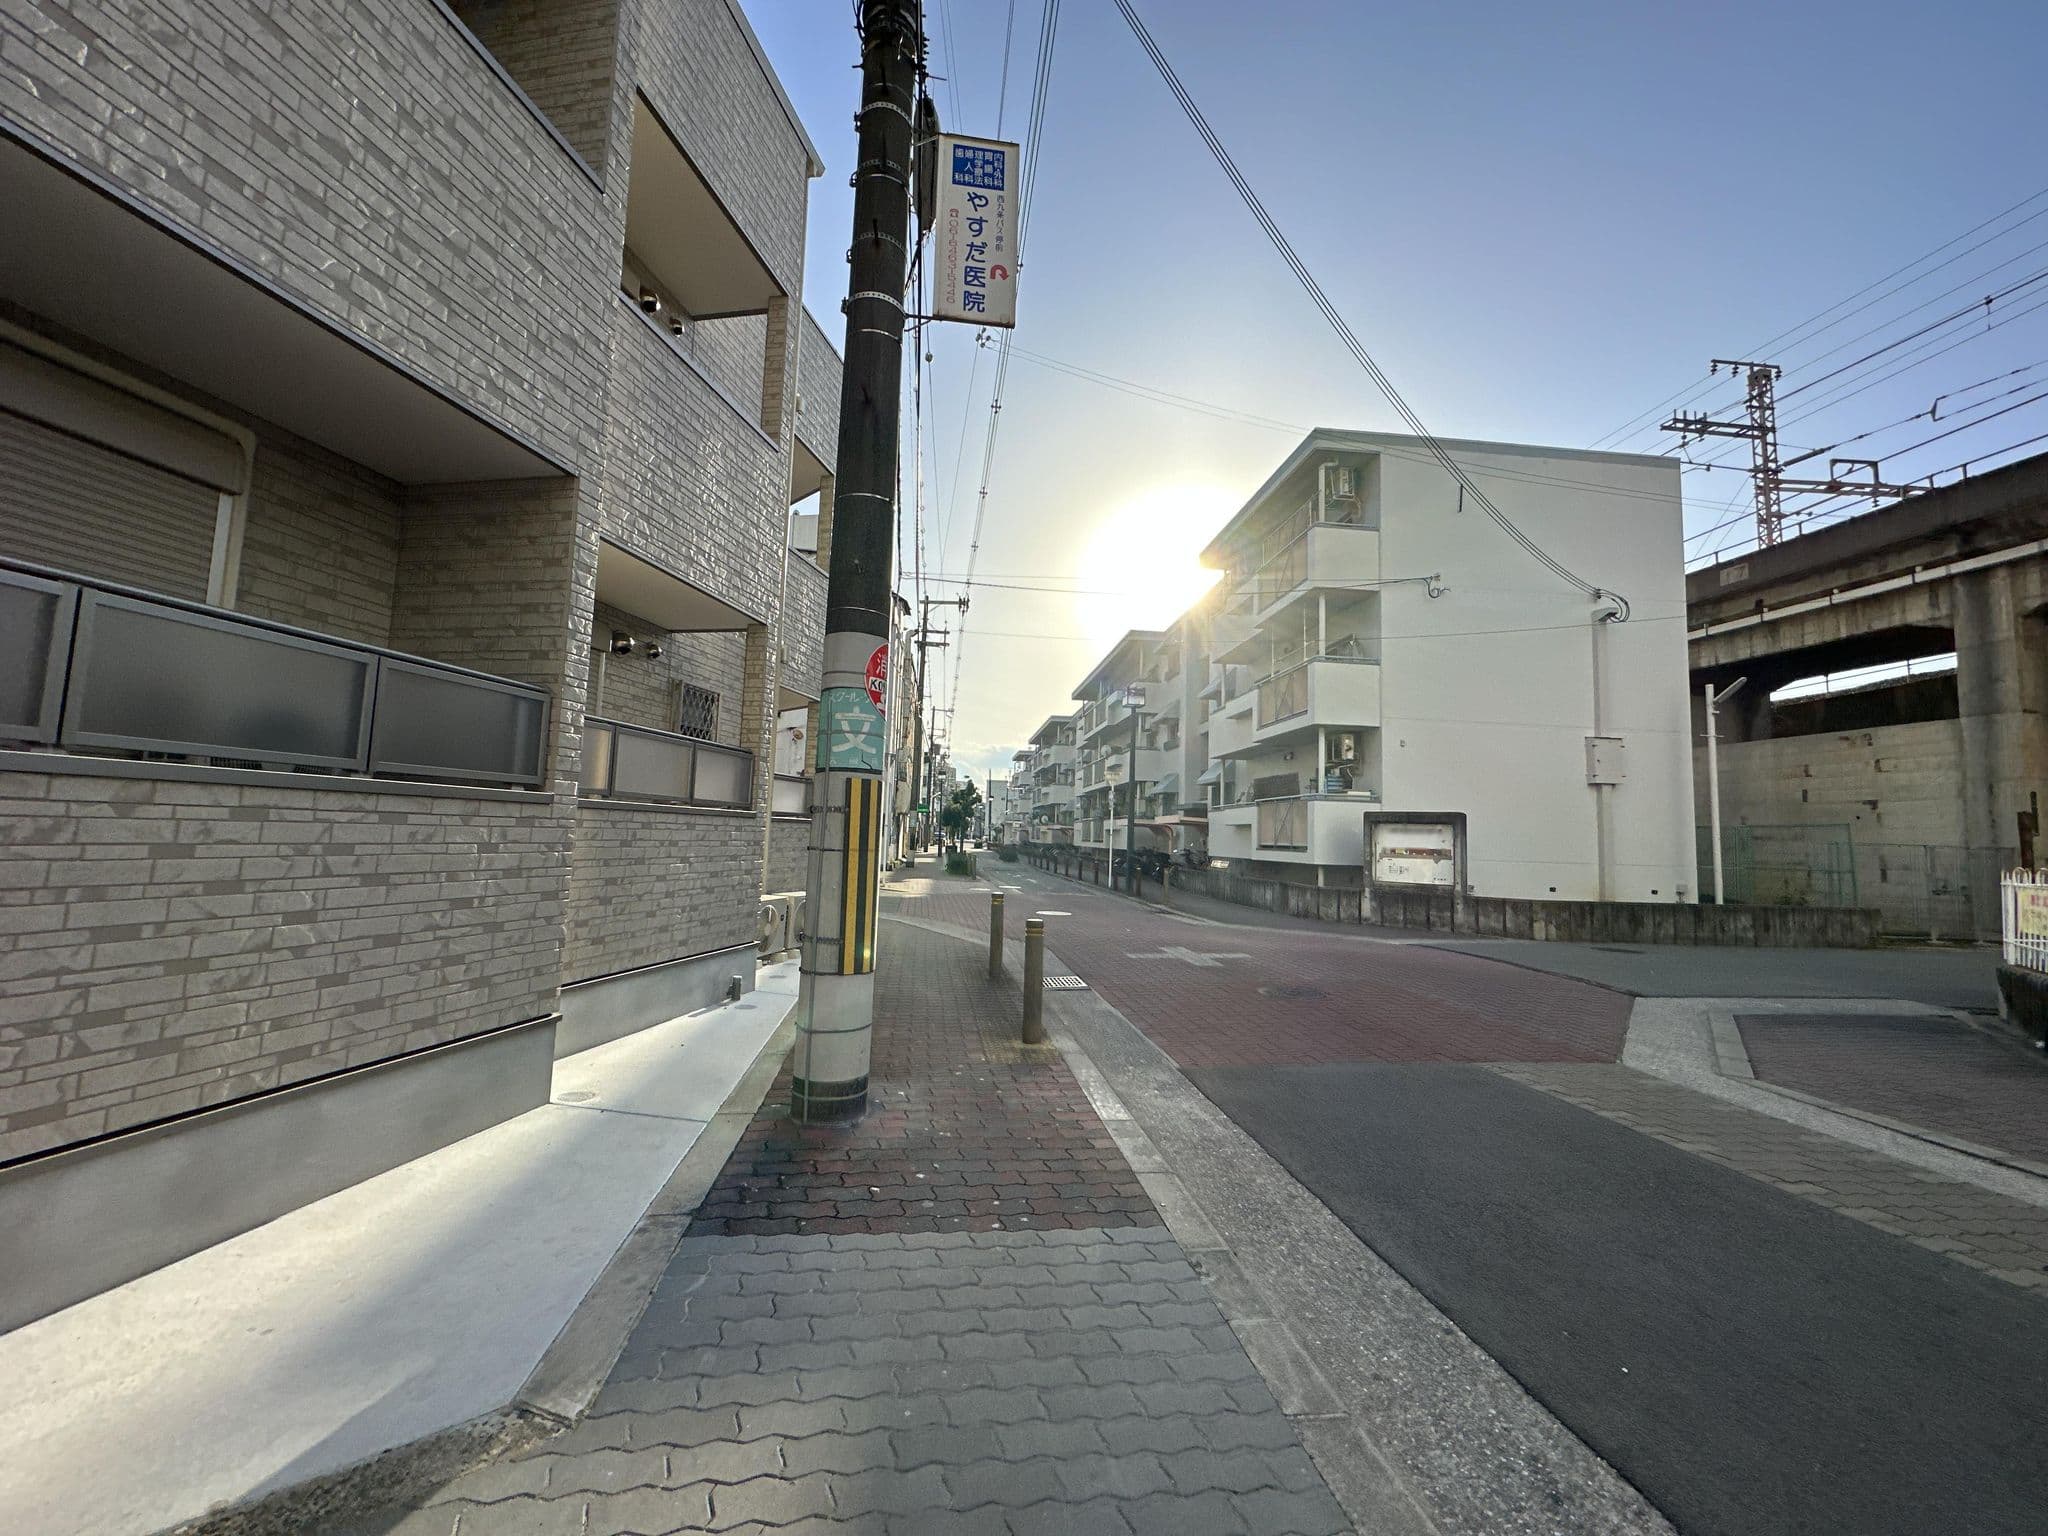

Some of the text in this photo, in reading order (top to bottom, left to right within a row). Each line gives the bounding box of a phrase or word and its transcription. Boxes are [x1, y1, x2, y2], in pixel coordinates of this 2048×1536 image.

[963, 191, 989, 313] やすだ医院
[832, 705, 876, 754] 文
